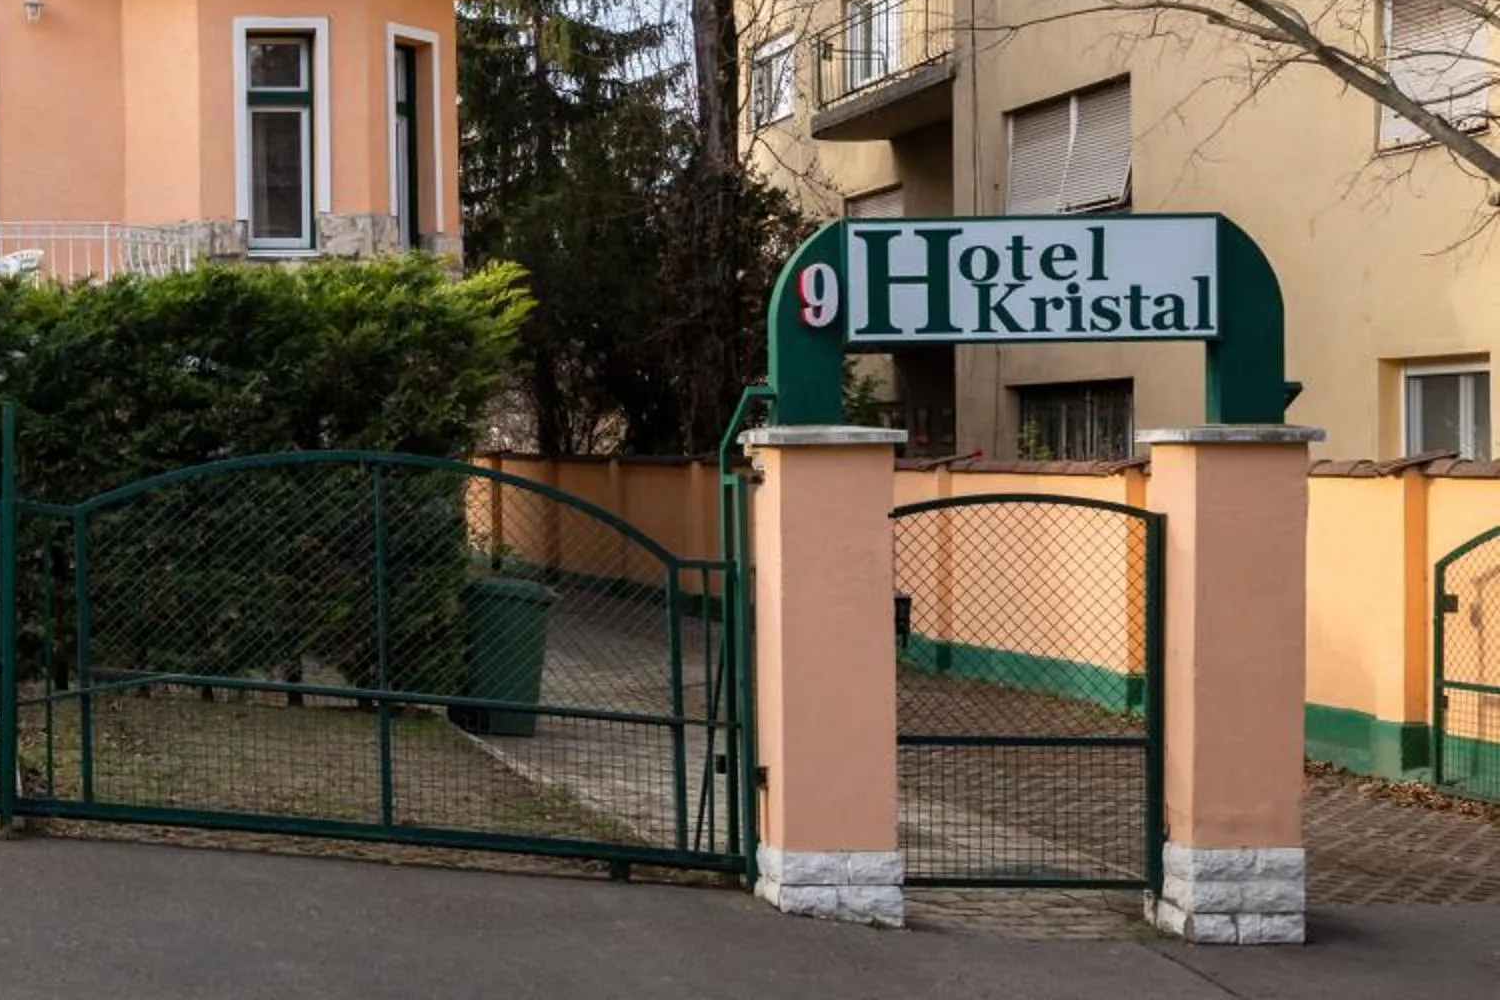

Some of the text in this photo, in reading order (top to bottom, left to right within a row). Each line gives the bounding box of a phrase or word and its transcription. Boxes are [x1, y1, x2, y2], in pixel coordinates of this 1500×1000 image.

[800, 263, 840, 328] 9
[854, 227, 1109, 335] Hotel
[971, 276, 1215, 333] Kristal
